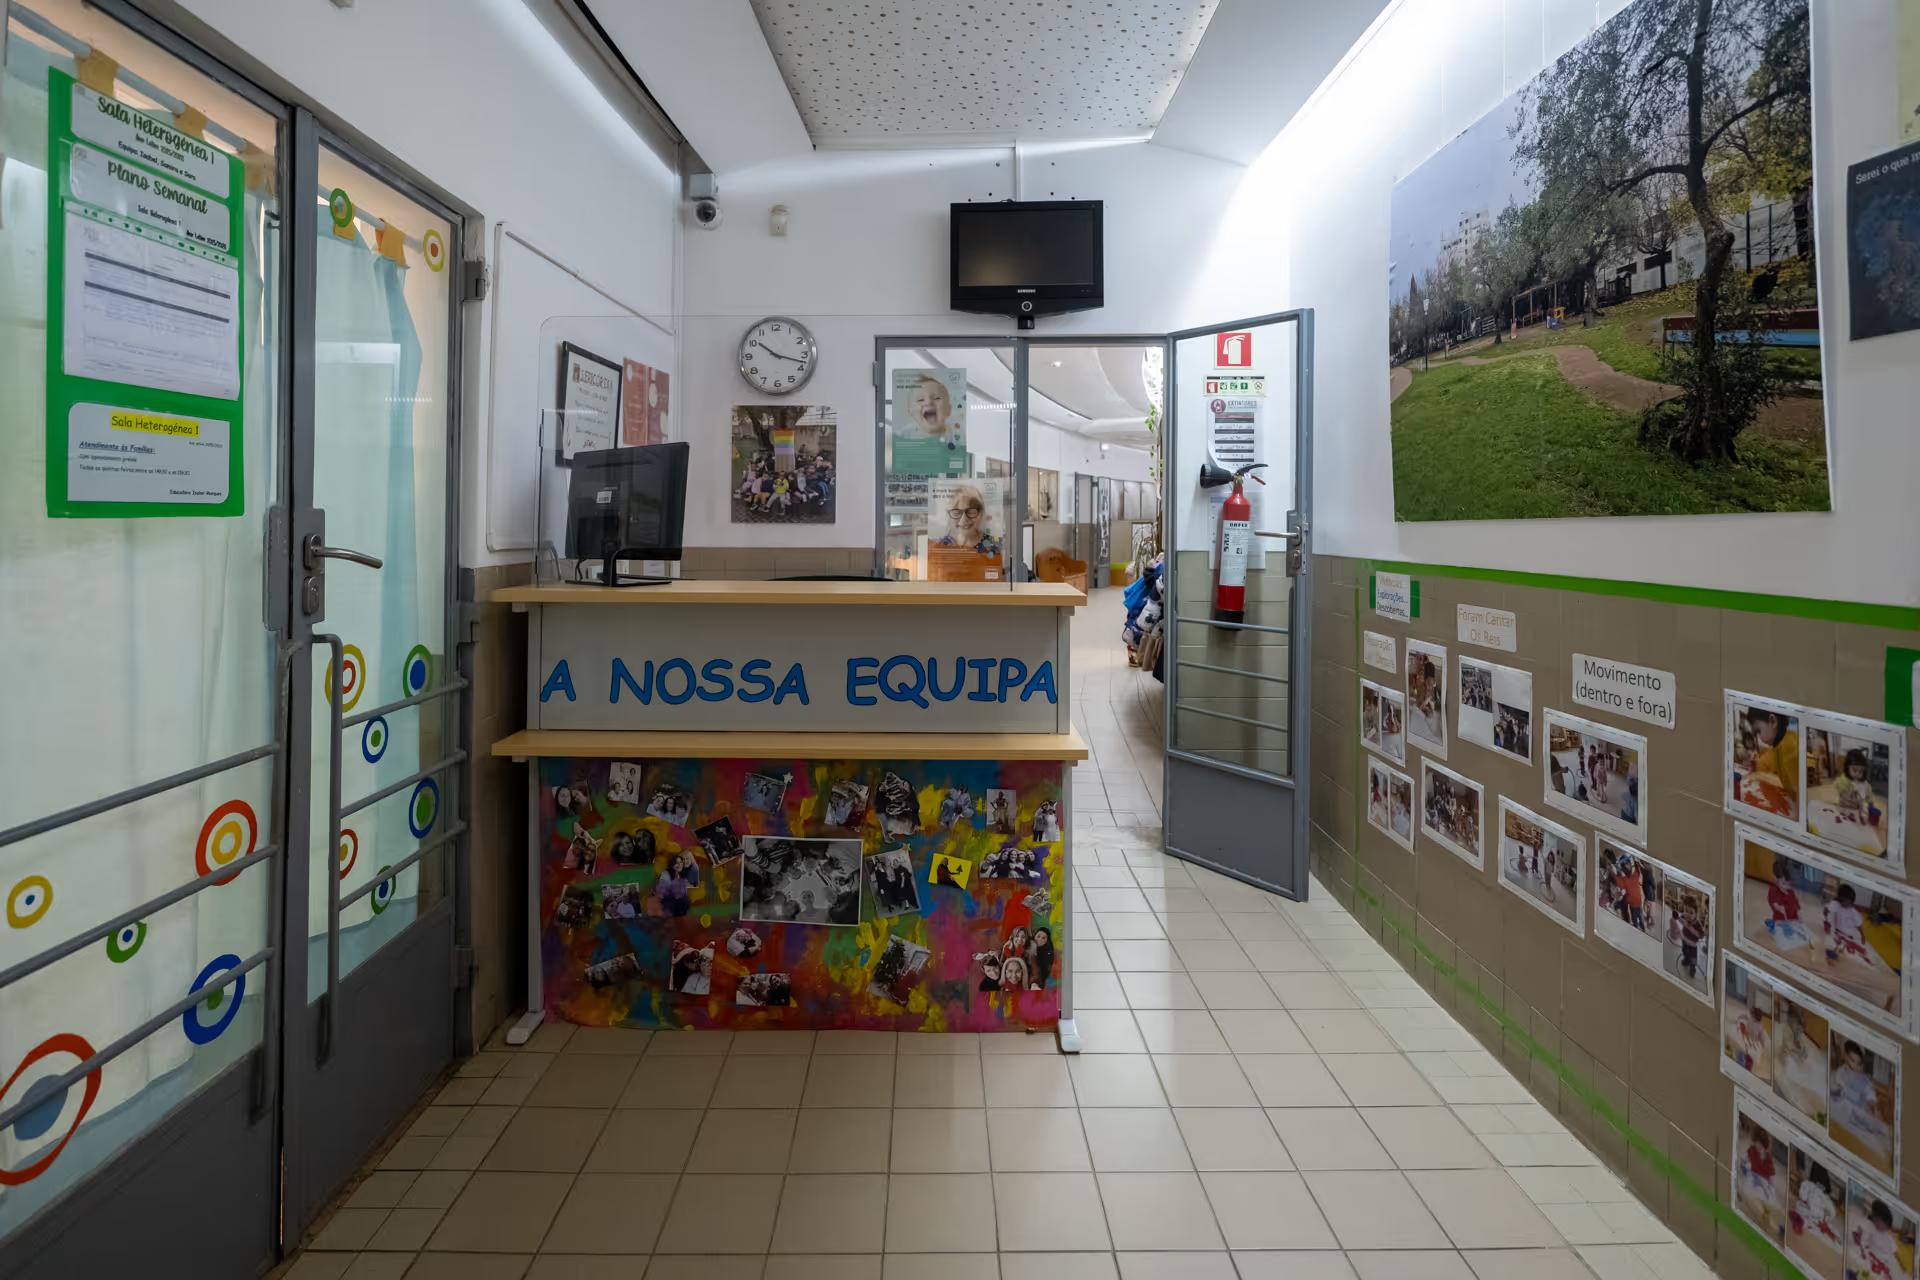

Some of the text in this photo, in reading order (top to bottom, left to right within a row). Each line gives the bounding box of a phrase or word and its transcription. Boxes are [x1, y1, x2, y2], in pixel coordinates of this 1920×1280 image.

[97, 96, 131, 124] Sala
[1855, 166, 1880, 185] Serei
[1882, 164, 1889, 174] o
[1890, 156, 1910, 173] que
[108, 160, 208, 214] Plano Semanal
[758, 328, 765, 336] 11
[771, 323, 782, 332] 12
[748, 339, 758, 347] 10
[796, 336, 804, 345] 2
[800, 351, 809, 359] 3
[750, 366, 759, 375] 8
[760, 376, 767, 384] 7
[774, 379, 782, 388] 6
[787, 375, 796, 383] 5
[111, 415, 133, 428] Sala
[135, 418, 193, 435] Heterogénea
[1584, 659, 1662, 691] Movimento
[539, 655, 1058, 709] A NOSSA EQUIPA
[1575, 680, 1672, 724] (dentro e fora)
